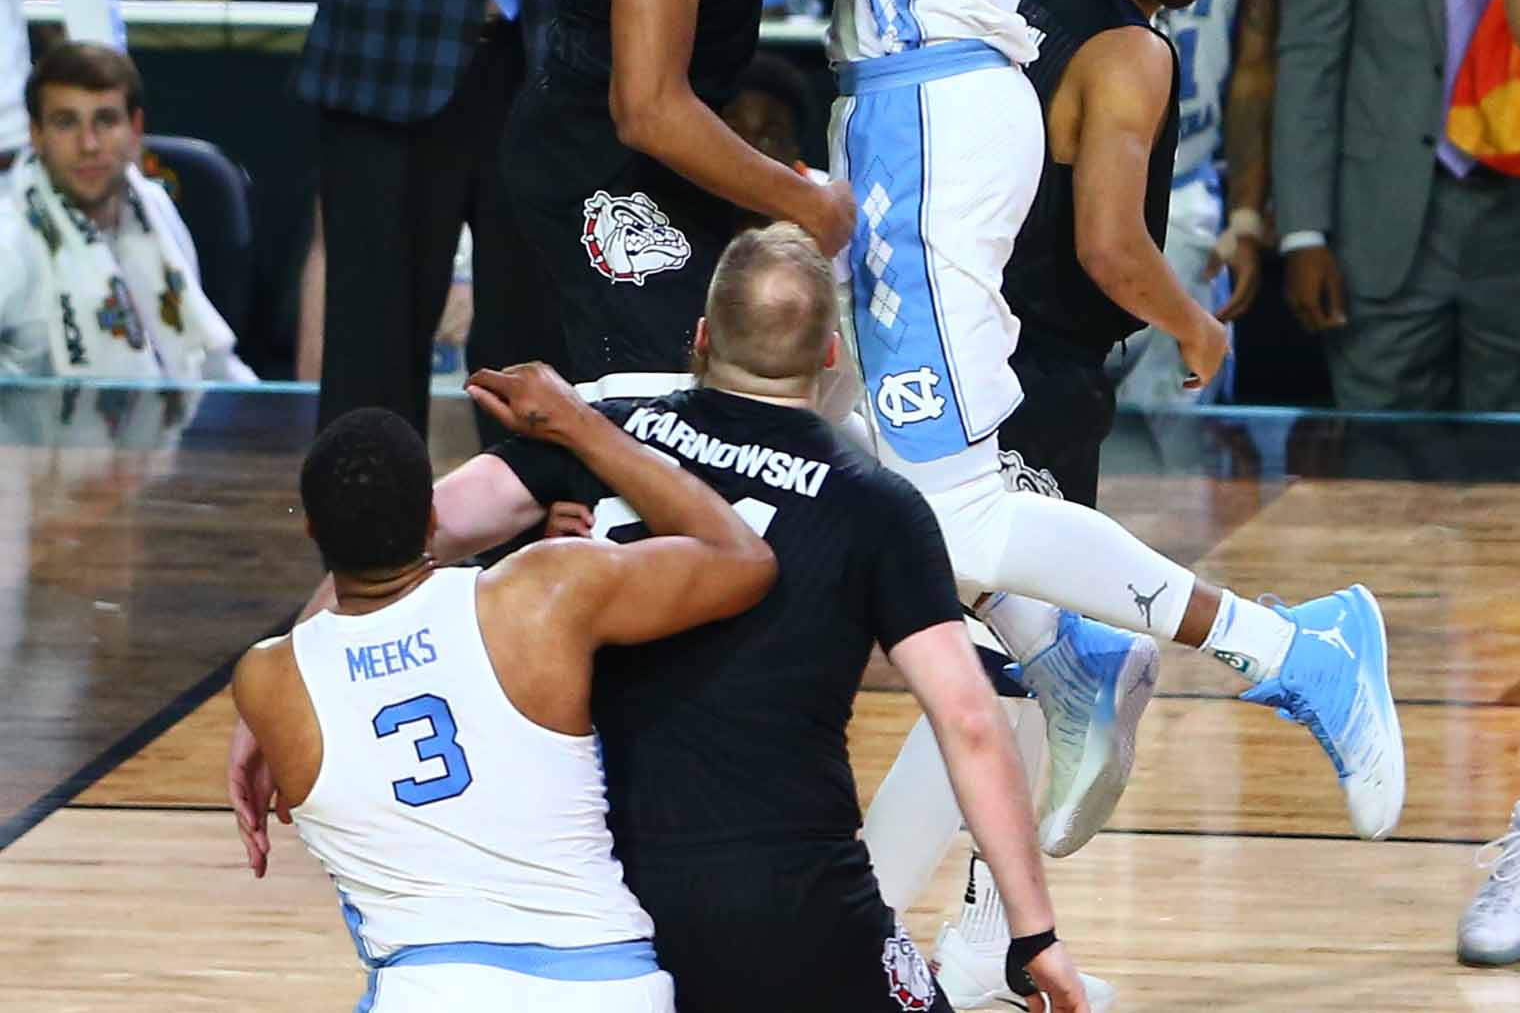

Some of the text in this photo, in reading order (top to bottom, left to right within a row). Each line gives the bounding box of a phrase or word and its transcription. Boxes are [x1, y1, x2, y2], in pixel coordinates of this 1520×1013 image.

[623, 406, 831, 498] KARNOWSKI
[345, 627, 437, 683] MEEKS
[371, 692, 473, 808] 3
